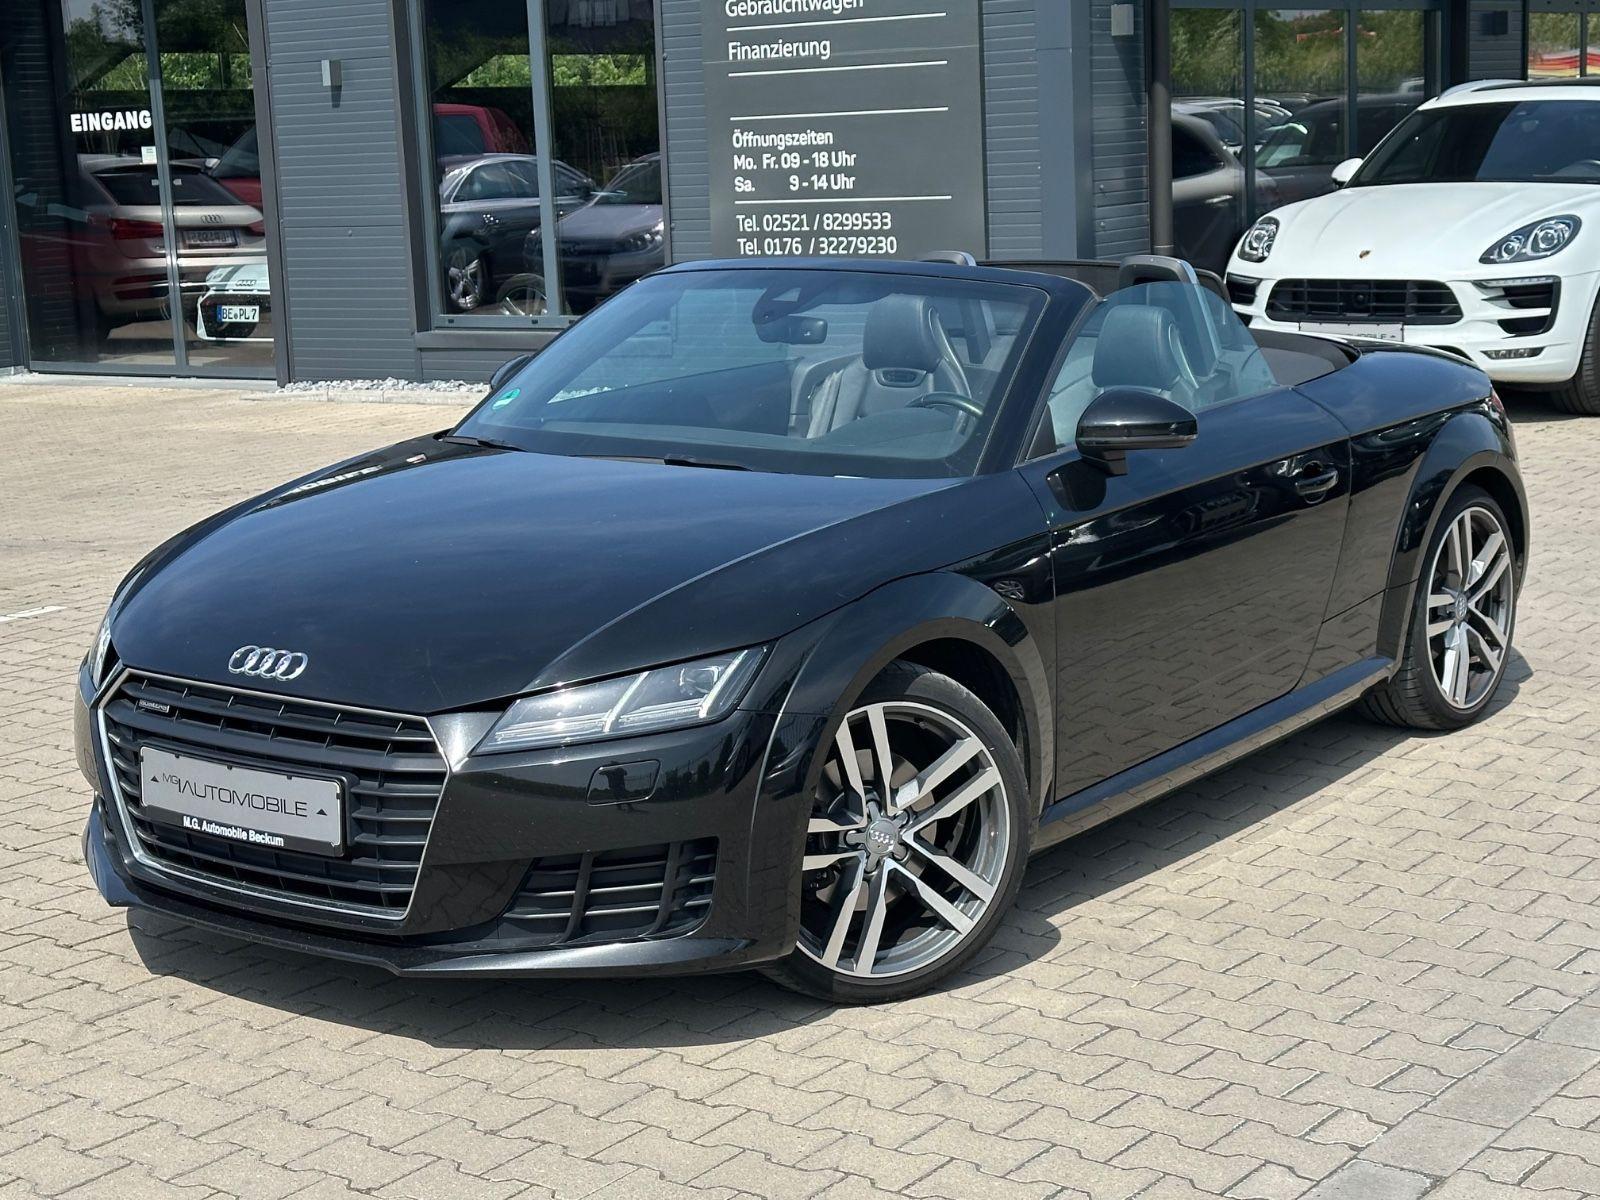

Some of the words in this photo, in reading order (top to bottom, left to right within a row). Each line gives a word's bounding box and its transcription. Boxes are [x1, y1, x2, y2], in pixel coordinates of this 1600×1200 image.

[725, 0, 864, 17] Gebrauchtwagen
[728, 39, 831, 60] Finanzierung
[70, 110, 152, 132] EINGANG
[732, 129, 834, 151] Öffnungszeiten
[733, 155, 757, 170] Mo.
[762, 154, 779, 169] Fr.
[781, 153, 801, 168] 09
[811, 151, 829, 167] 18
[831, 151, 857, 167] Uhr
[734, 176, 755, 192] Sa.
[789, 175, 799, 191] 9
[811, 174, 828, 190] 14
[830, 173, 855, 190] Uhr
[736, 214, 760, 231] Tel.
[762, 214, 810, 231] 02521
[823, 212, 892, 230] 8299533
[737, 238, 761, 255] Tel.
[764, 238, 802, 255] 0176
[819, 236, 898, 255] 32279230
[183, 815, 200, 830] M.G.
[202, 820, 248, 841] Automobile
[249, 830, 284, 847] Beckum
